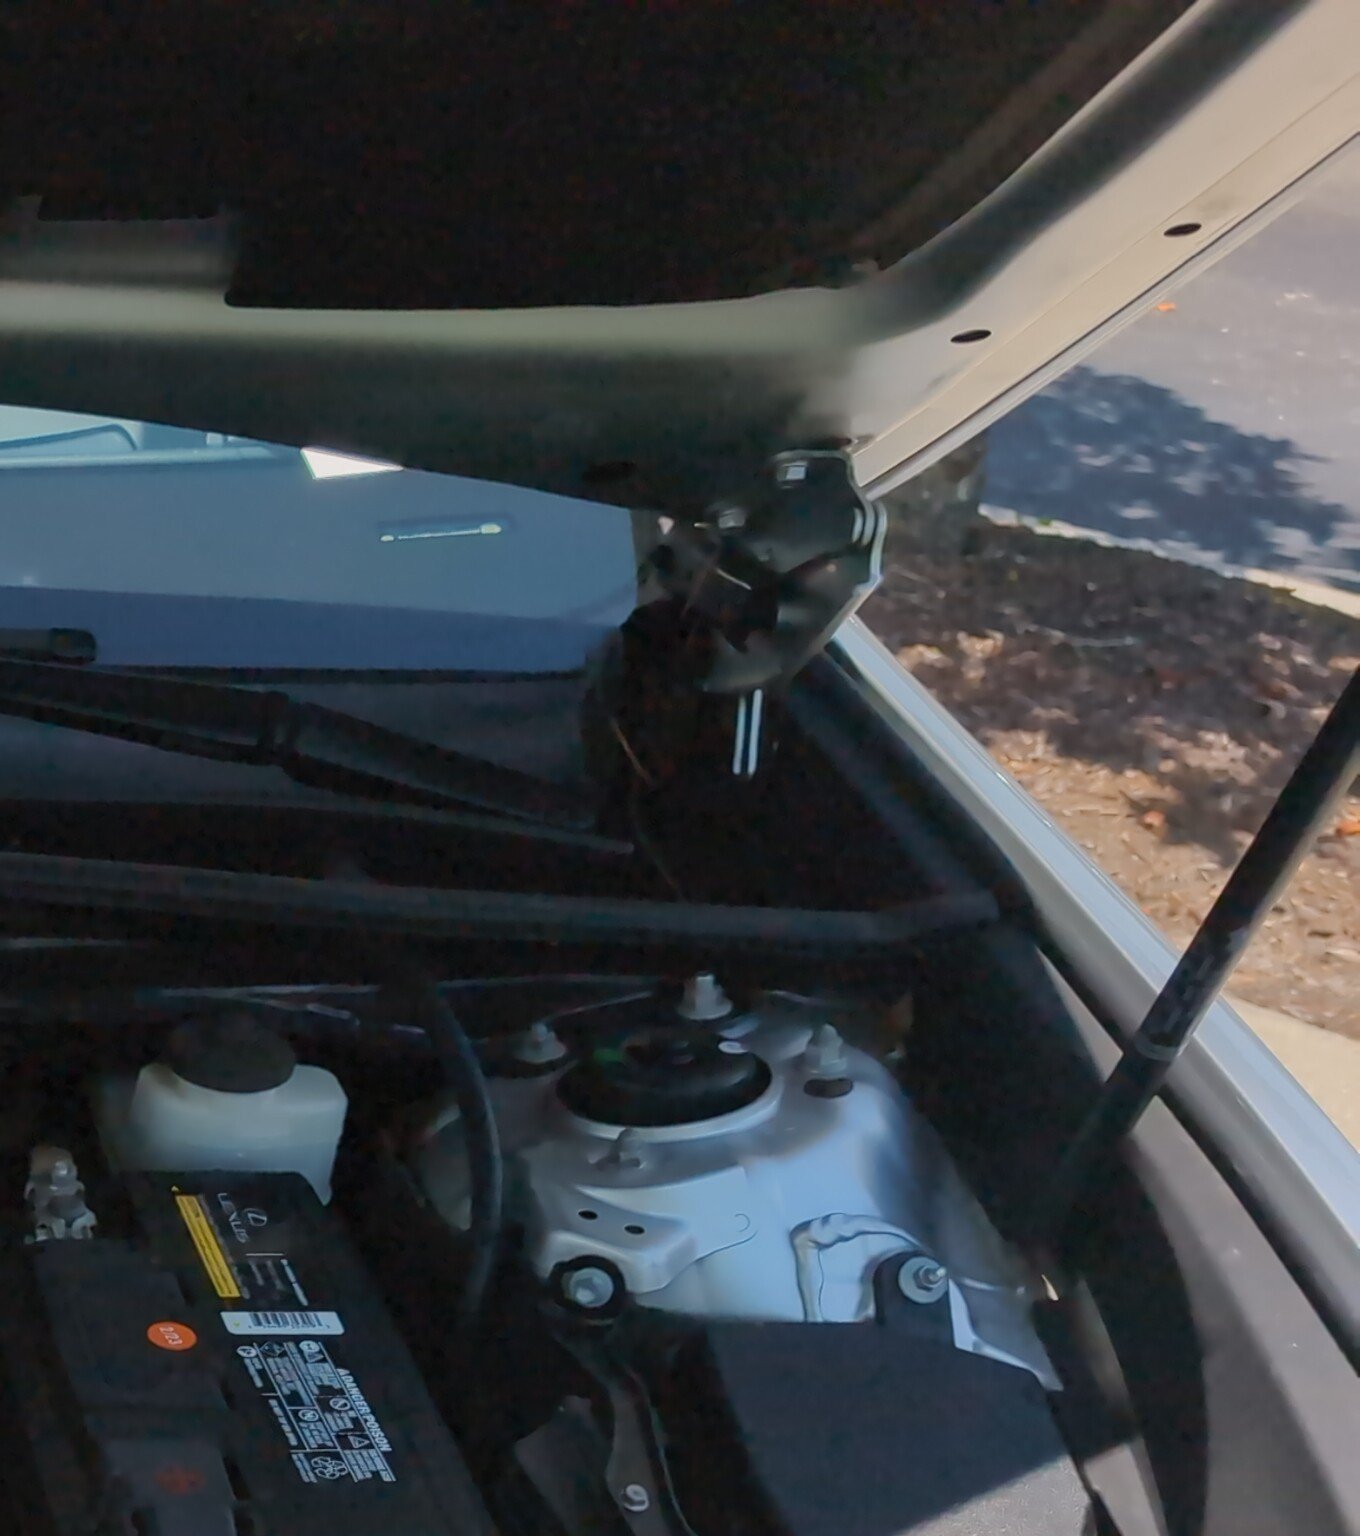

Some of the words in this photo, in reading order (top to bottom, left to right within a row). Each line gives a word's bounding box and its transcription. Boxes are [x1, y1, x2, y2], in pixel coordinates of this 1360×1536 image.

[217, 1192, 250, 1244] LEXUS
[340, 1373, 372, 1416] DANGER
[363, 1414, 393, 1452] POISON
